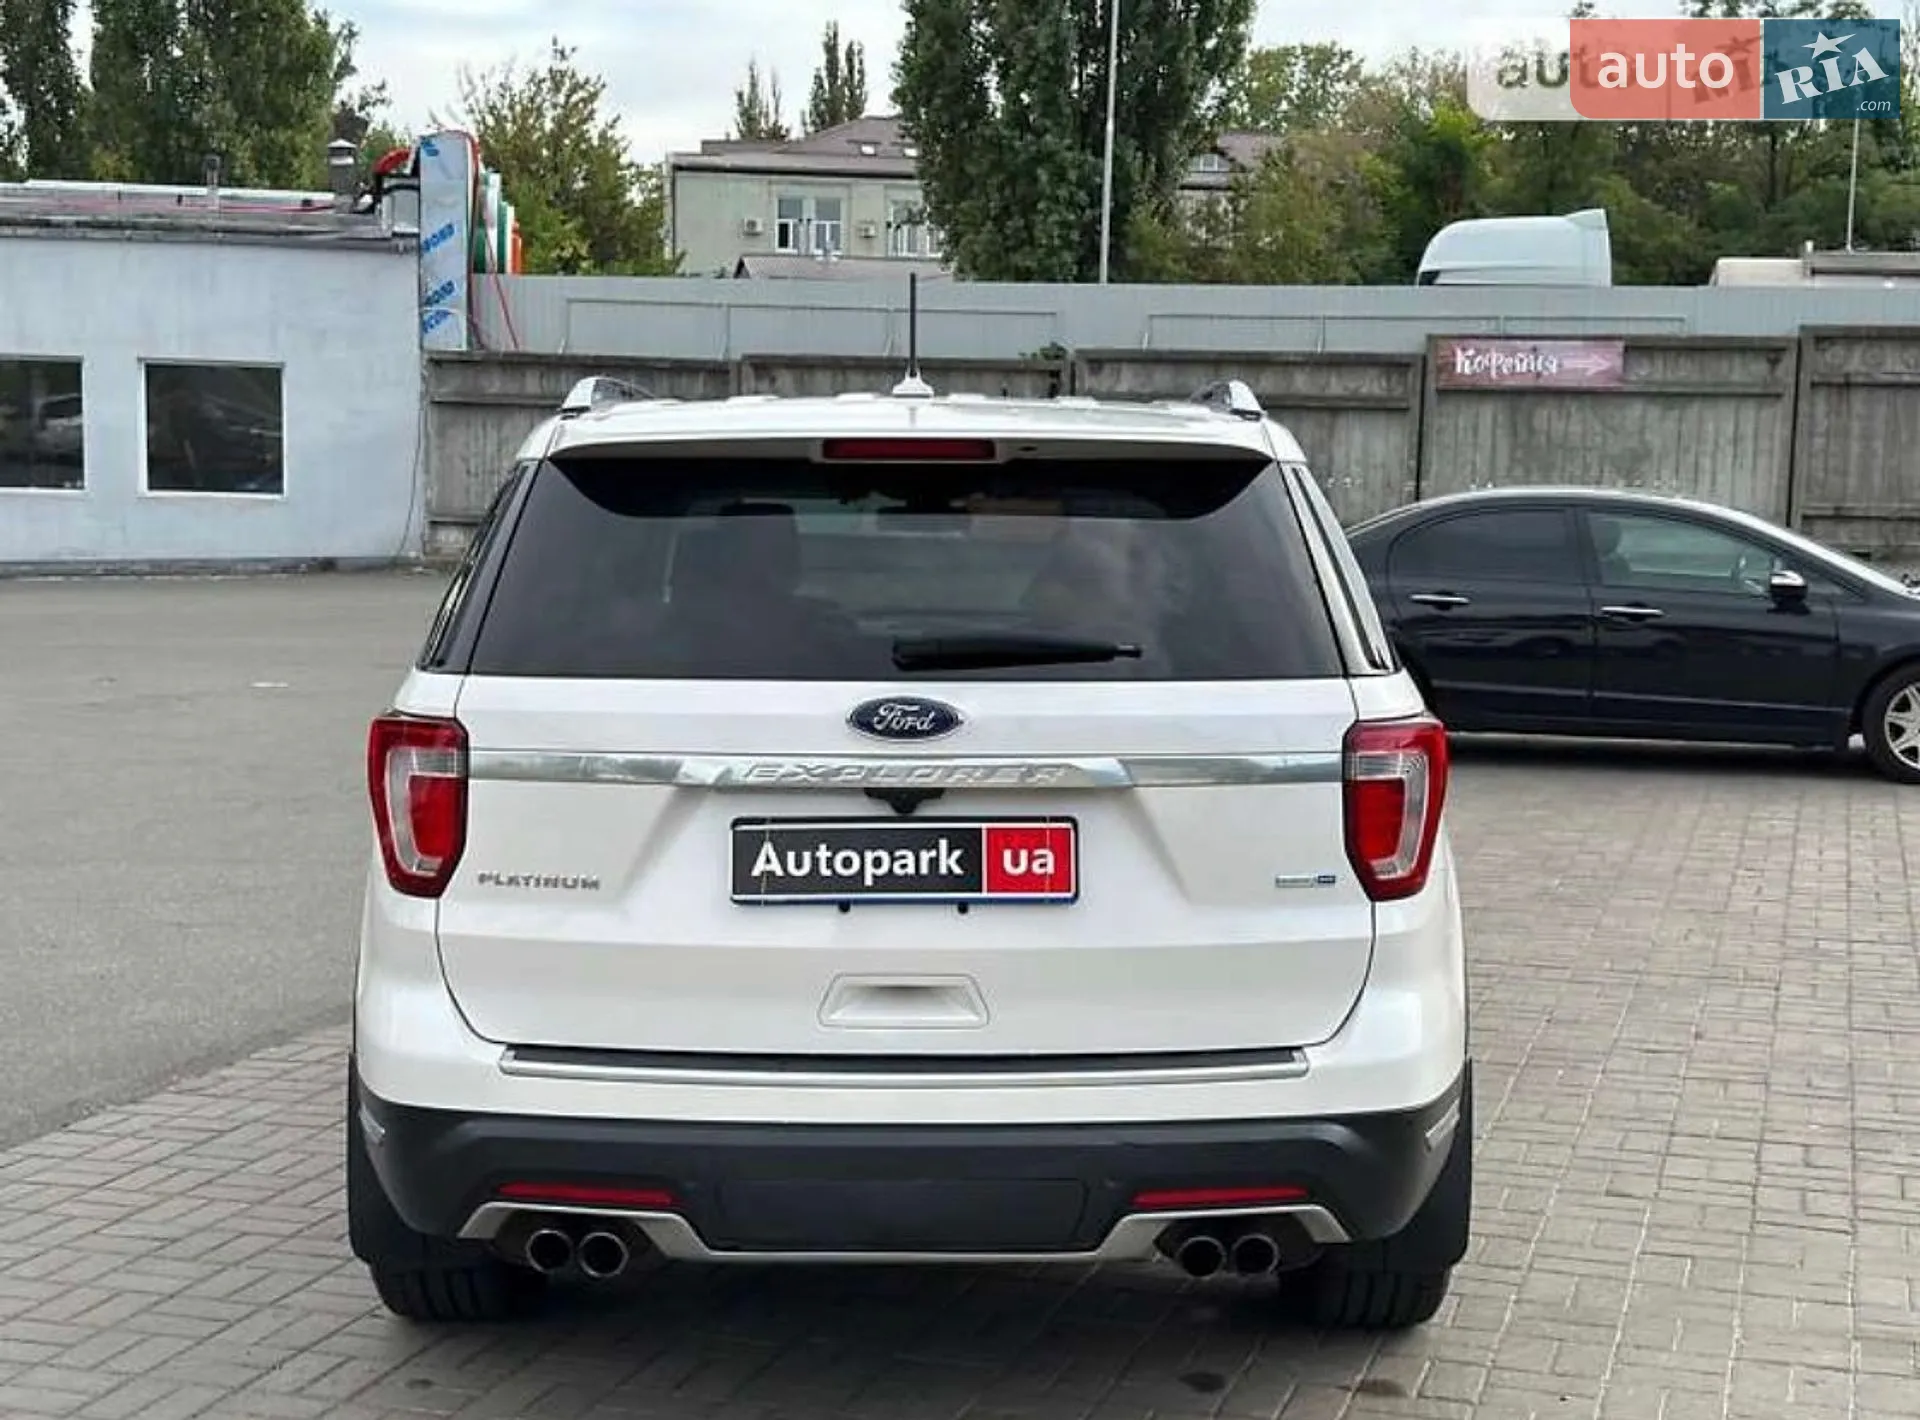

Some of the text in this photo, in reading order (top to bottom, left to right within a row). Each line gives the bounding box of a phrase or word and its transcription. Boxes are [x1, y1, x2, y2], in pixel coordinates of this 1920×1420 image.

[873, 703, 936, 730] Ford
[745, 761, 1066, 784] EXPLORER
[751, 838, 1055, 886] Autopark ua
[478, 872, 600, 890] PLATINUM
